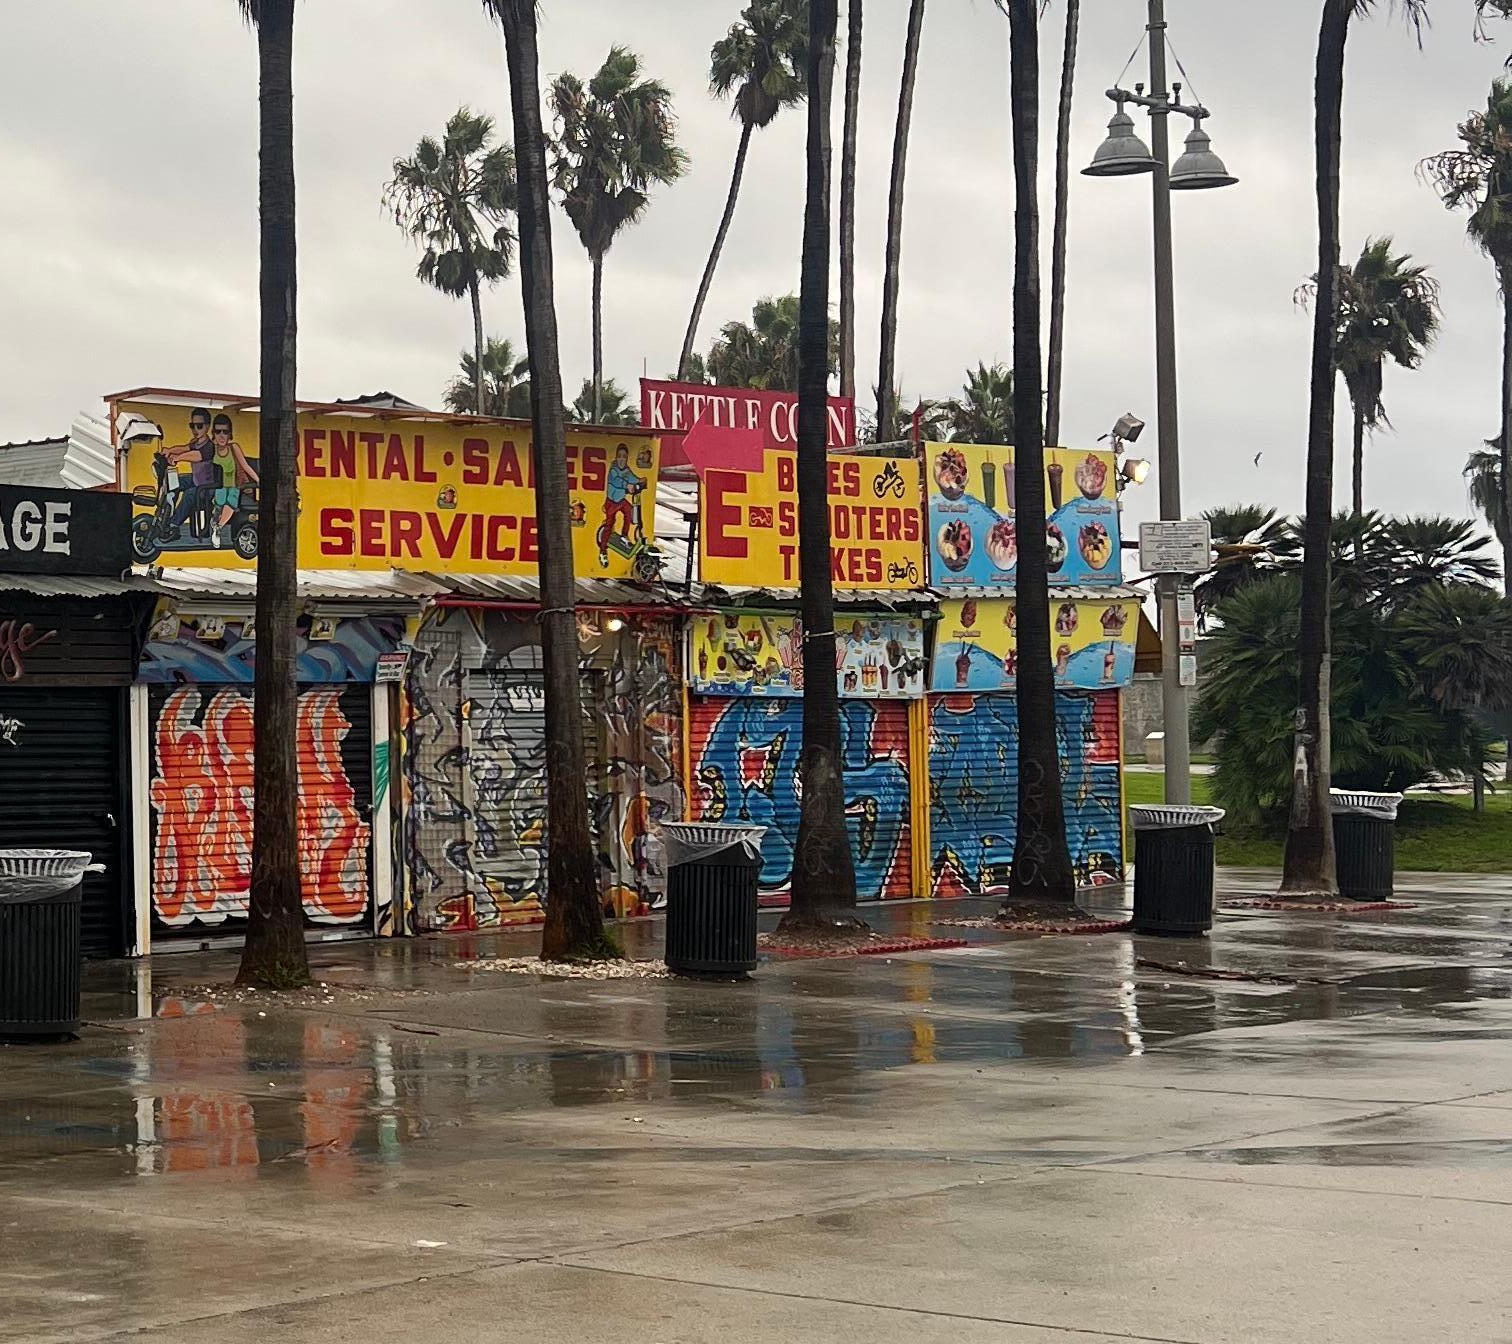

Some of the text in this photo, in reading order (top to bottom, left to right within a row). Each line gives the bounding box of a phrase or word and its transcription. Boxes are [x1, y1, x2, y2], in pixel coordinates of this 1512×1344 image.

[296, 428, 438, 483] ENTAL
[778, 456, 861, 498] BES
[320, 507, 538, 563] SERVICE
[779, 501, 920, 542] SOTERS
[779, 545, 883, 583] TKES
